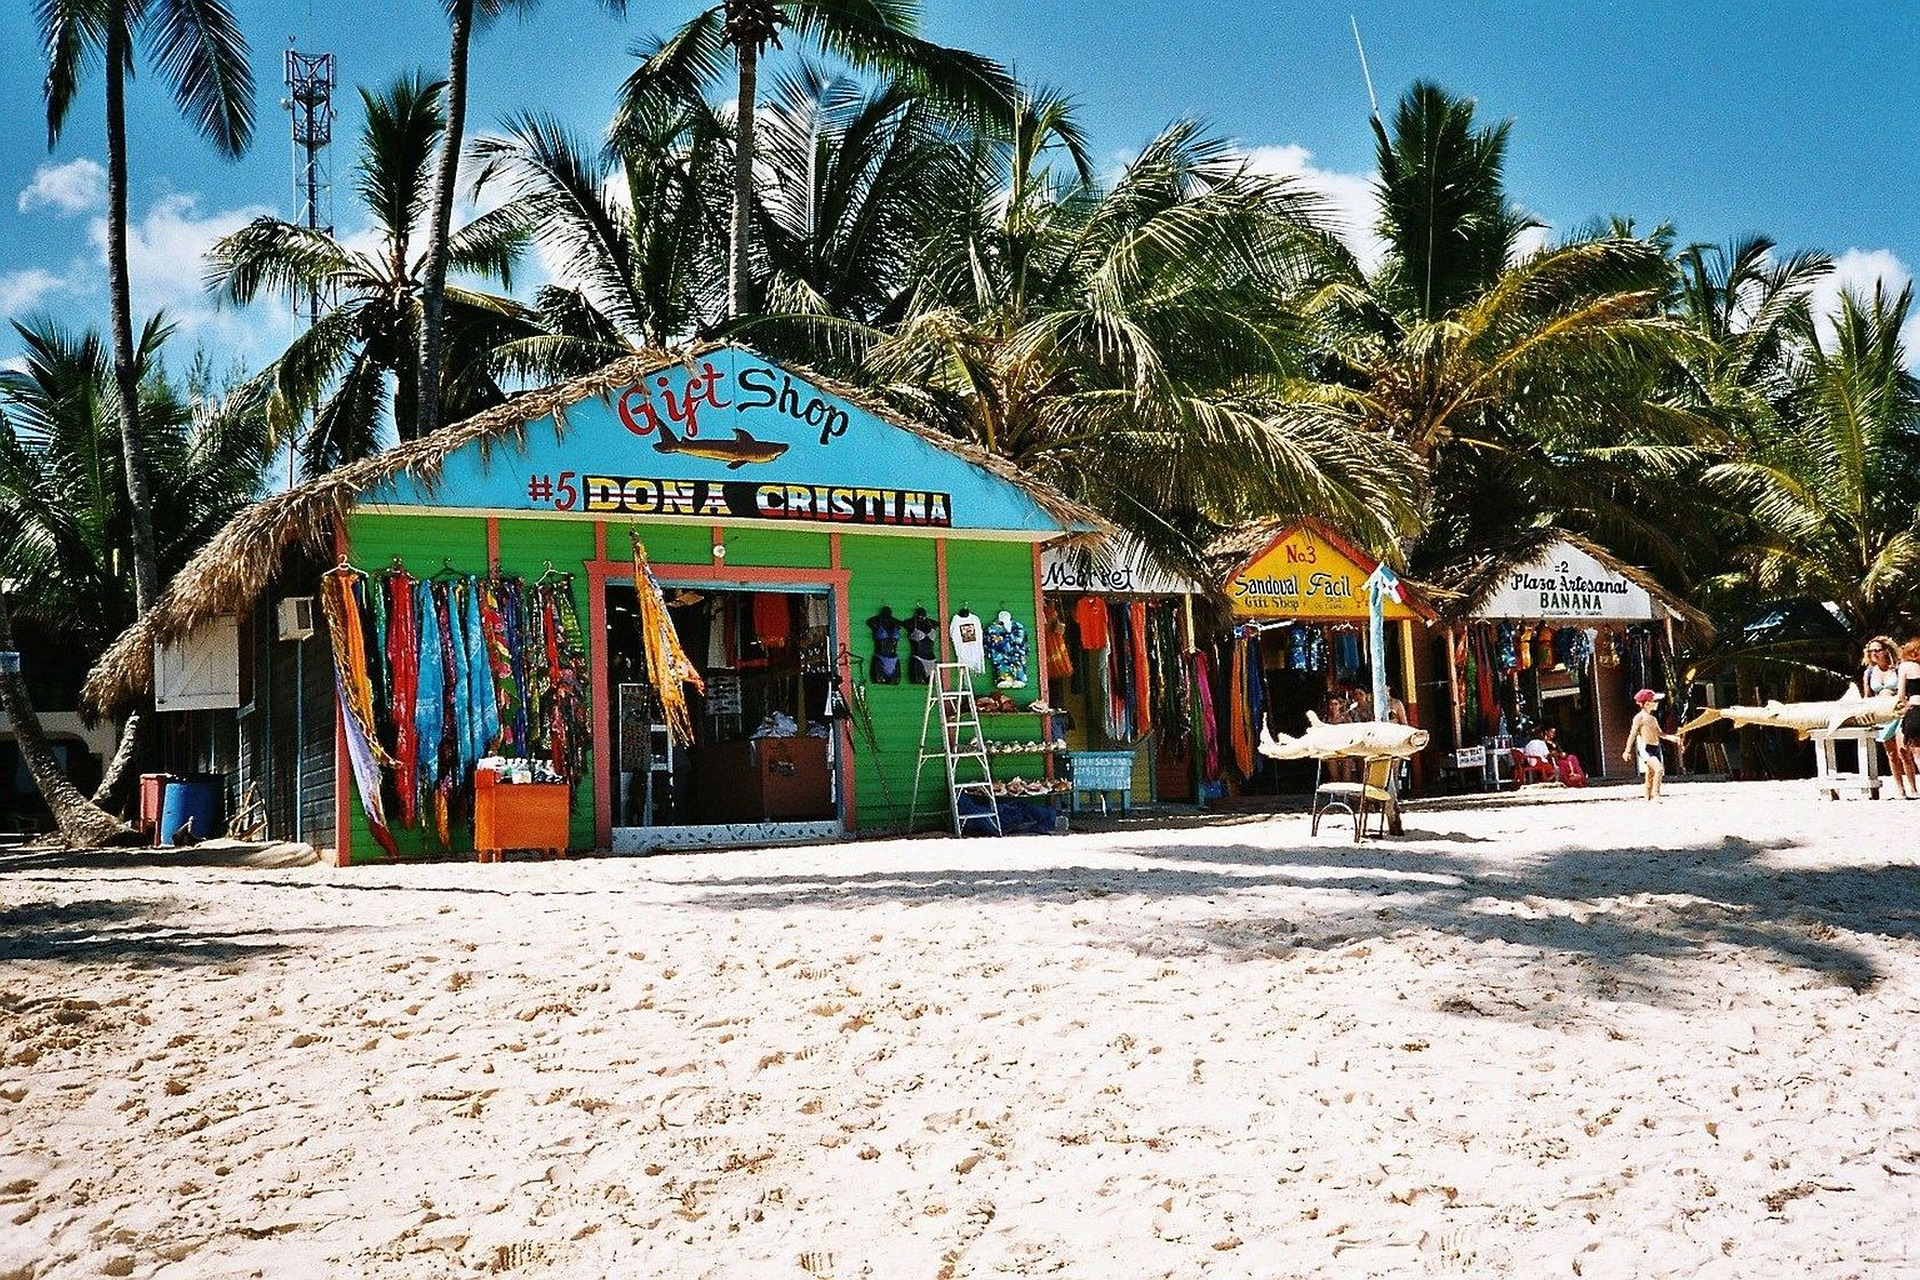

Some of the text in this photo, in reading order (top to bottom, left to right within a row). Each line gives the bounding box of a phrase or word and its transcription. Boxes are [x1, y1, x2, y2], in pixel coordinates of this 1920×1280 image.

[617, 362, 849, 445] Gift Shop
[528, 471, 577, 512] #5
[755, 485, 950, 527] CRISTINA
[1234, 572, 1351, 597] Sandoval Facil
[1511, 573, 1628, 595] Plaza Artesanal
[1271, 596, 1299, 612] Shop
[1540, 592, 1602, 610] BANANA
